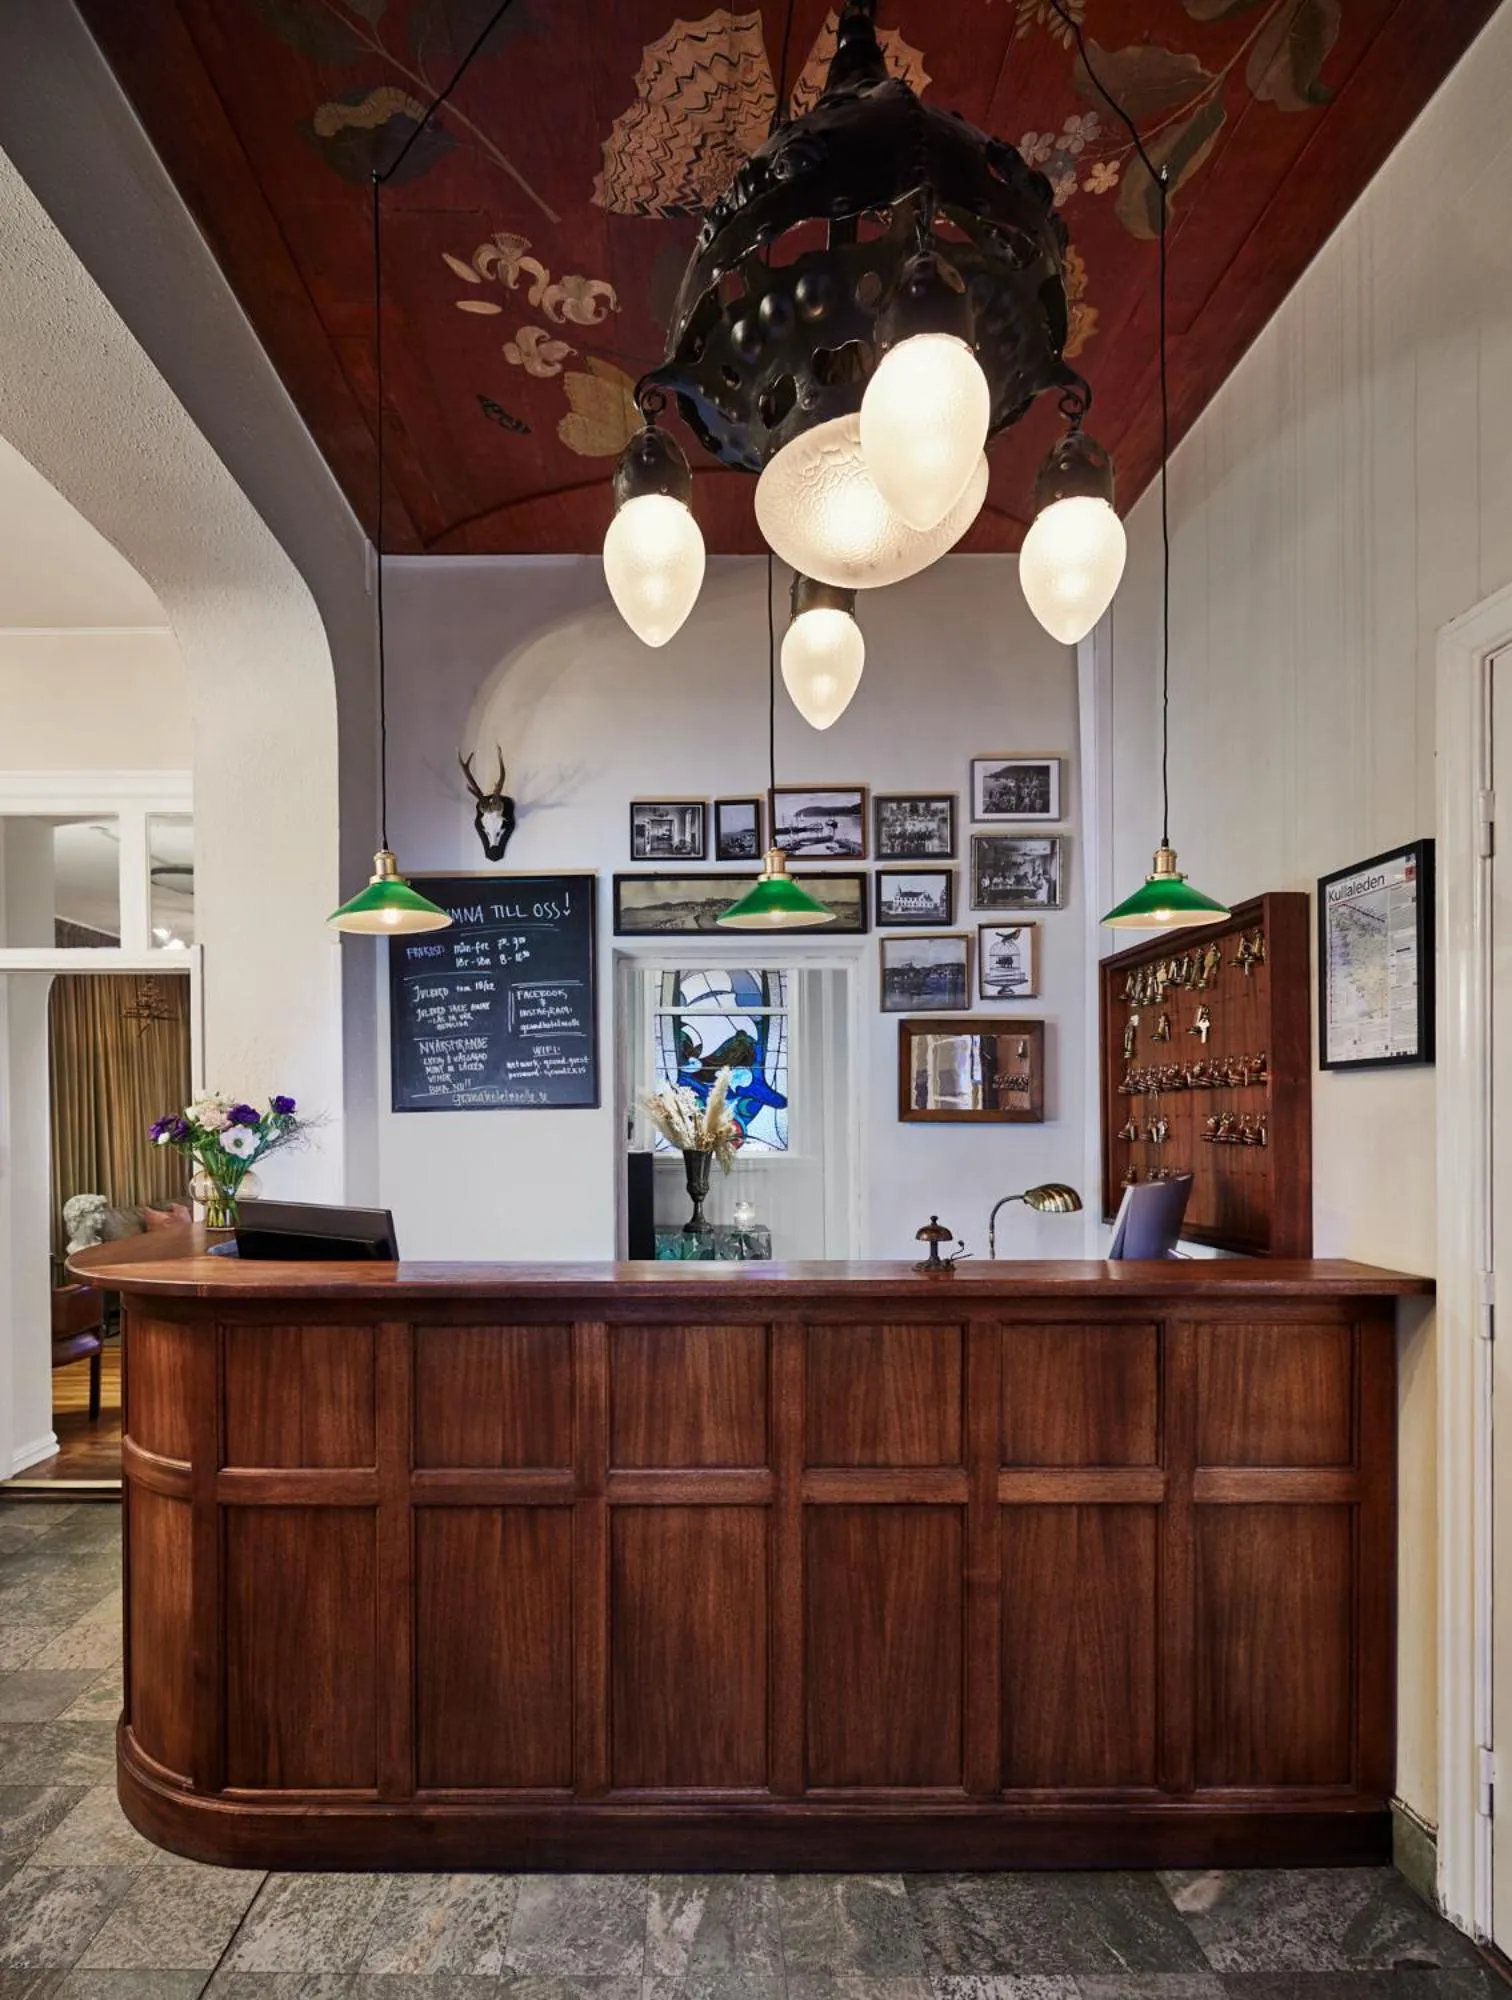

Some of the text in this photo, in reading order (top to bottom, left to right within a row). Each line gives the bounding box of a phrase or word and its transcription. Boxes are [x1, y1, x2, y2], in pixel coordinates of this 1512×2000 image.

[1328, 874, 1385, 902] Kullaleden
[447, 904, 485, 924] MNA
[490, 904, 529, 919] TILL
